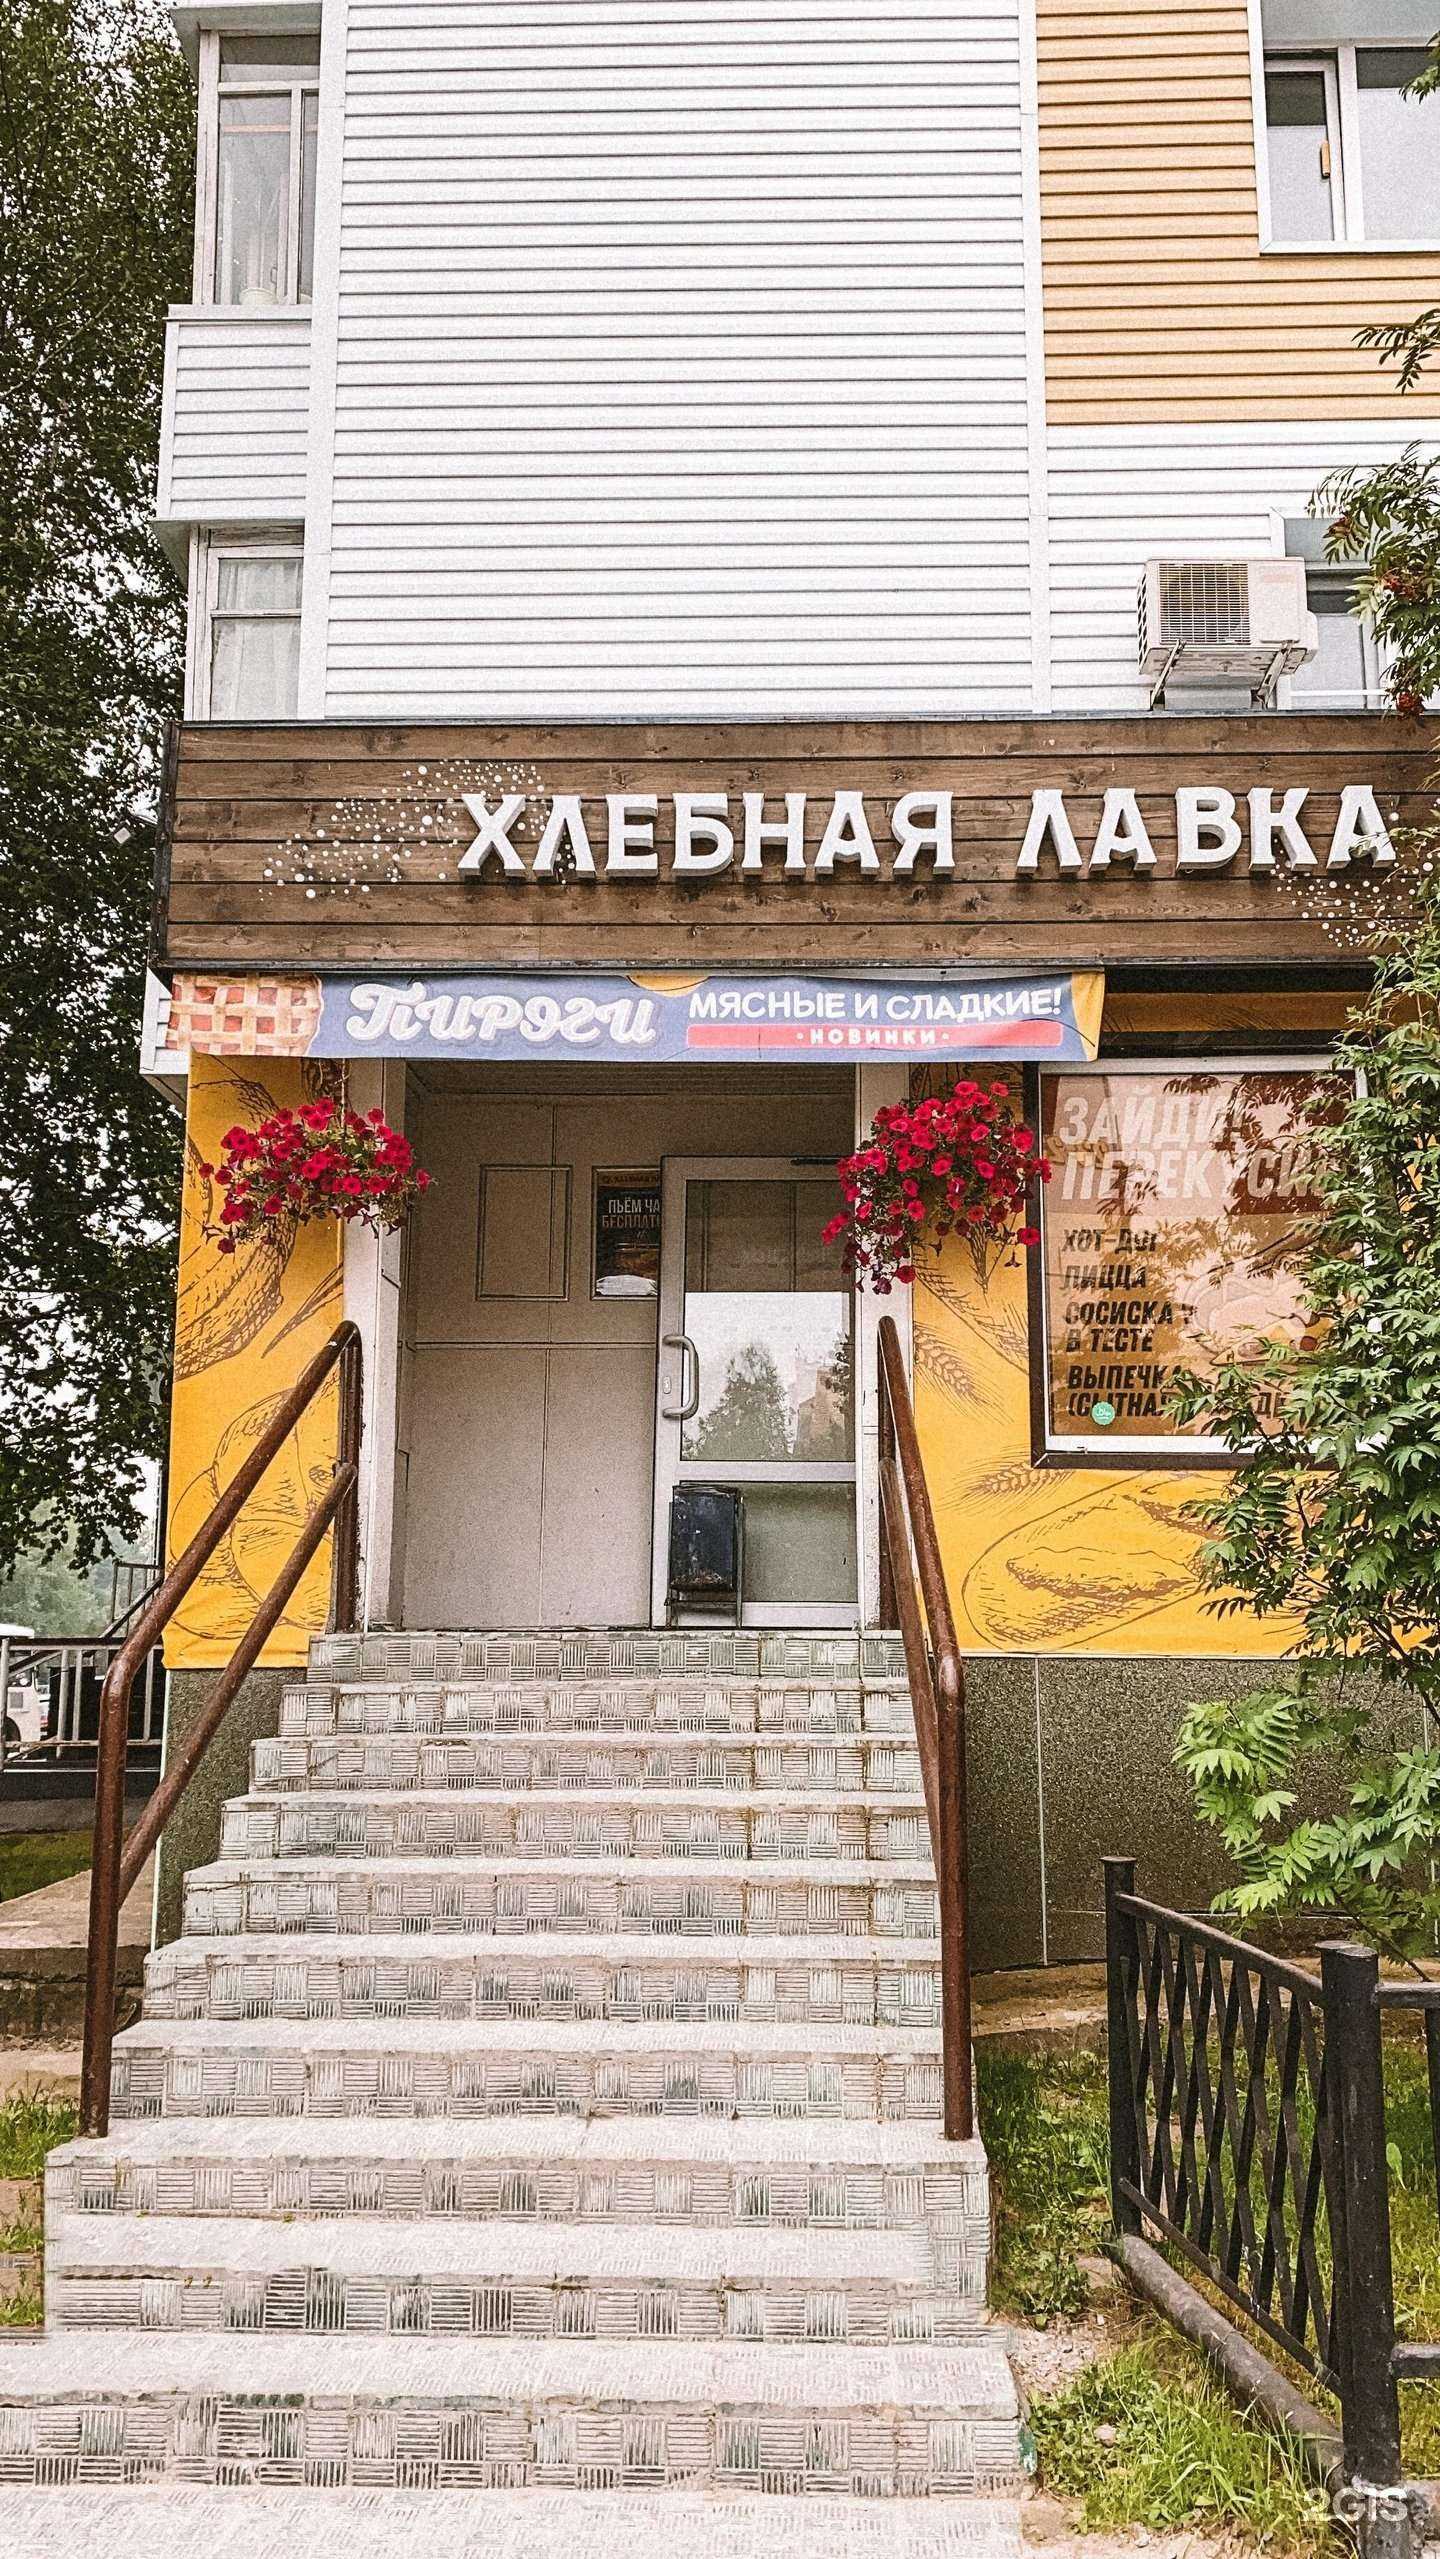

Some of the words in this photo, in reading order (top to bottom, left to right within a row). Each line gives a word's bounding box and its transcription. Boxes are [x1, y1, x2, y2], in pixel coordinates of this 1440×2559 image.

[458, 791, 955, 877] ХЛЕБНАЯ
[1016, 785, 1397, 874] ЛАВКА
[689, 992, 846, 1019] МЯСНЫЕ
[854, 994, 879, 1018] И
[886, 988, 1062, 1022] СЛАДКИЕ!
[809, 1029, 936, 1044] НОВИНКИ
[608, 1197, 642, 1214] ПЬЁМ
[645, 1198, 660, 1214] ЧА
[1062, 1264, 1146, 1291] ПИЦЦА
[1065, 1301, 1172, 1325] СОСИСКА
[1091, 1327, 1154, 1352] ТЕСТЕ
